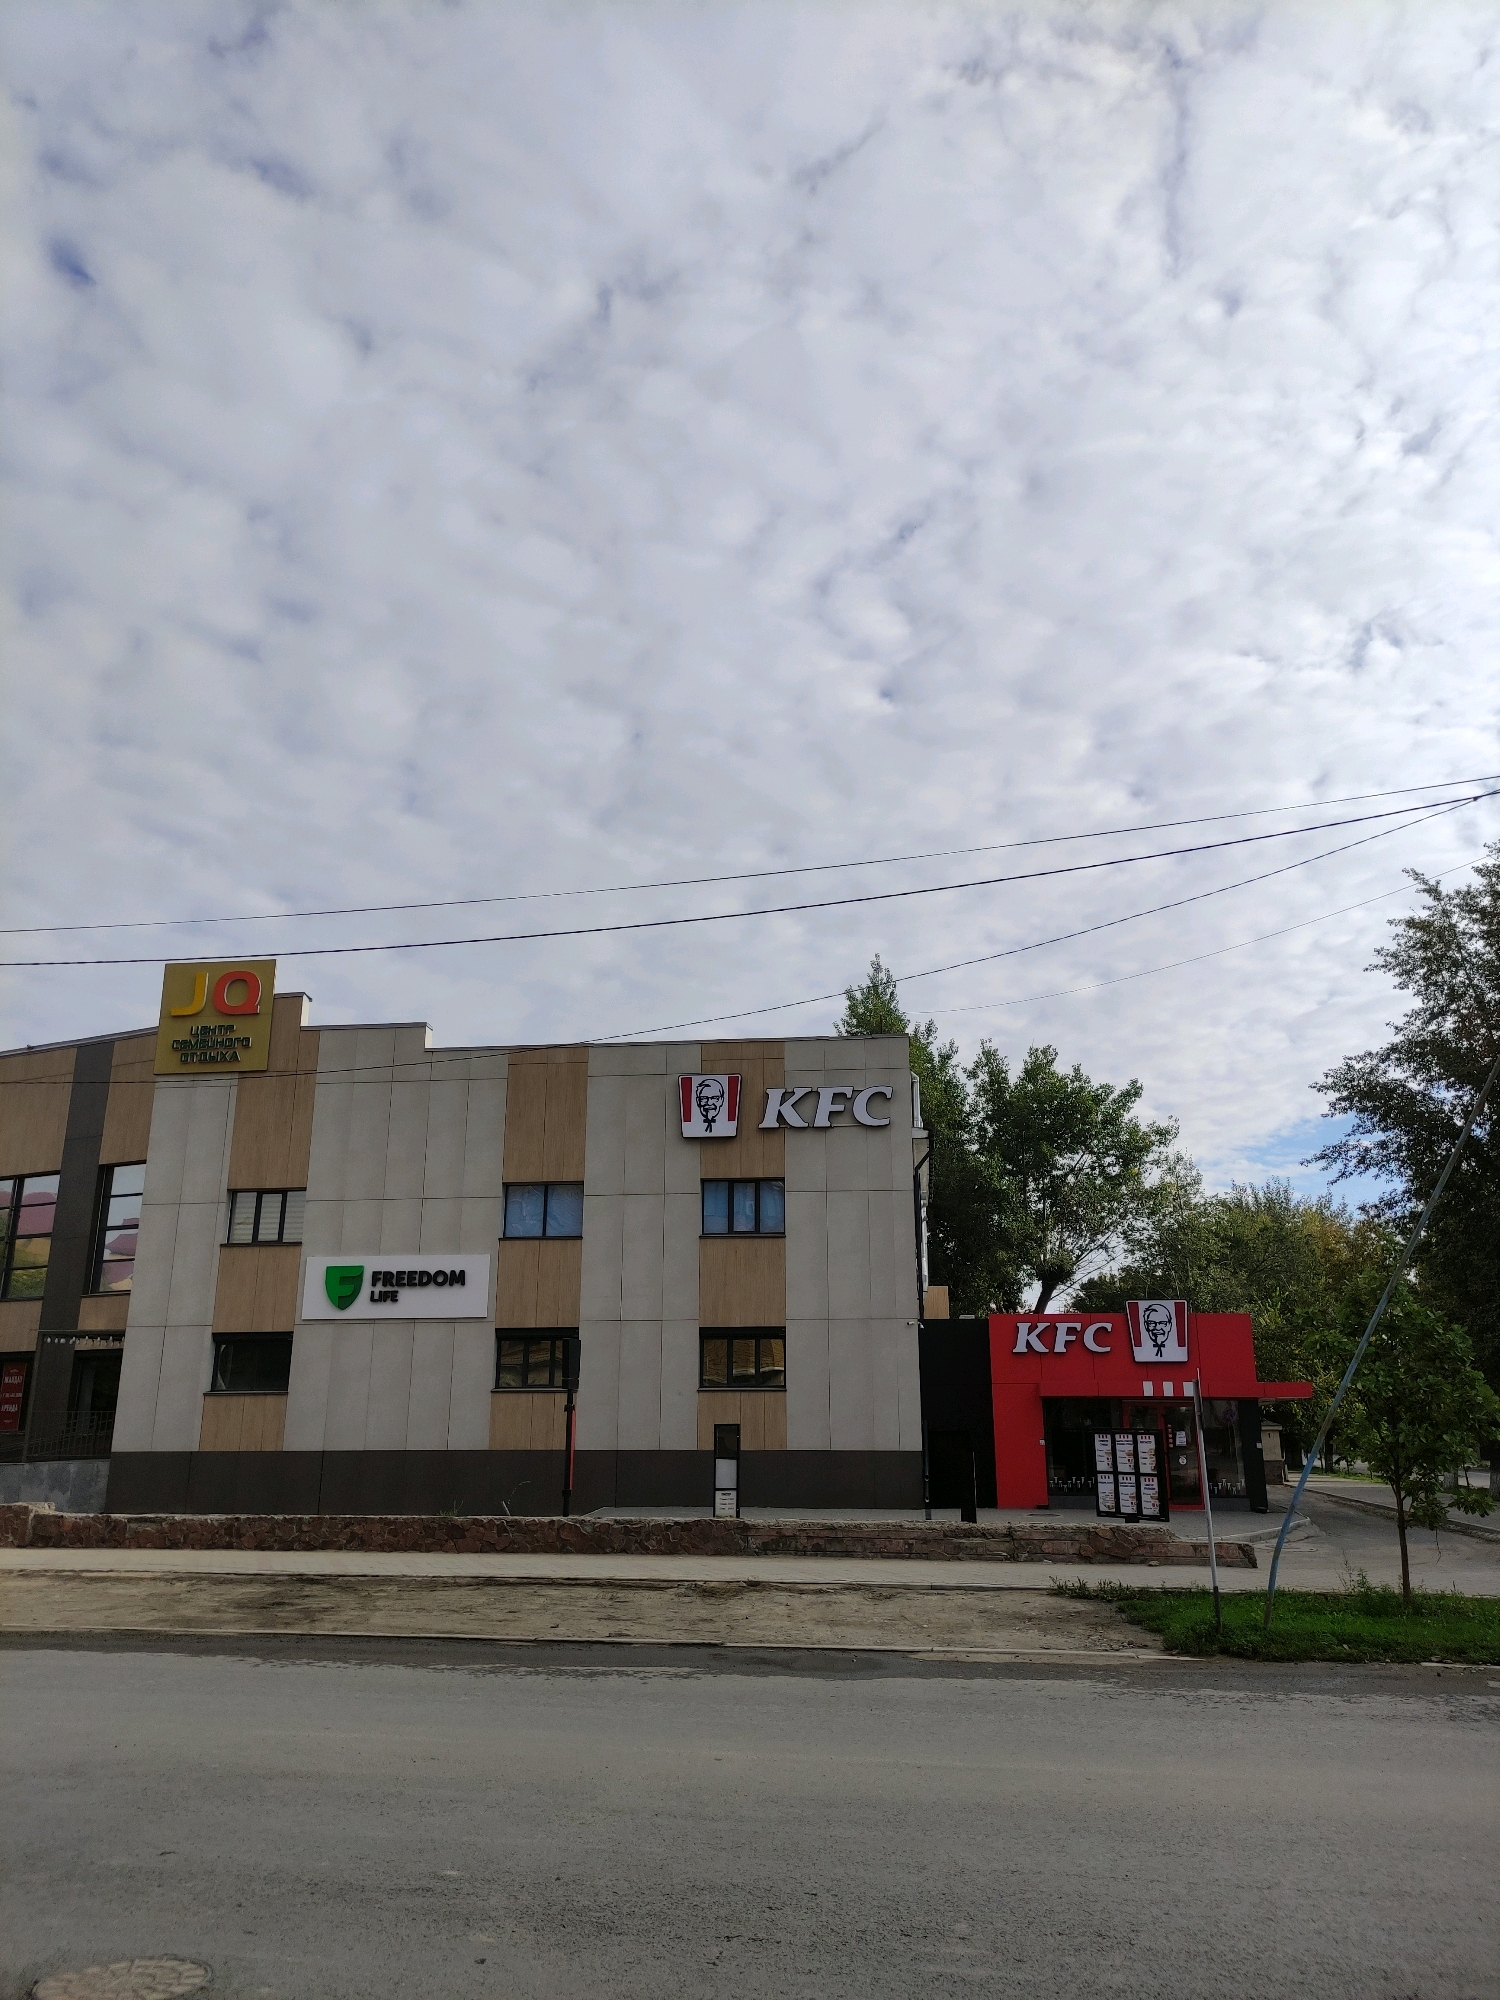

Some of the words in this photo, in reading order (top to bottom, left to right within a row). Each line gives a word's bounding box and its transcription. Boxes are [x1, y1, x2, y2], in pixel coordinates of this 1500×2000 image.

[190, 1024, 236, 1038] ЦЕНТР
[180, 1050, 241, 1063] ОТДЫХА
[758, 1085, 894, 1130] KFC
[371, 1269, 466, 1288] FREEDOM
[370, 1290, 399, 1303] LIFE
[1012, 1322, 1113, 1353] KFC
